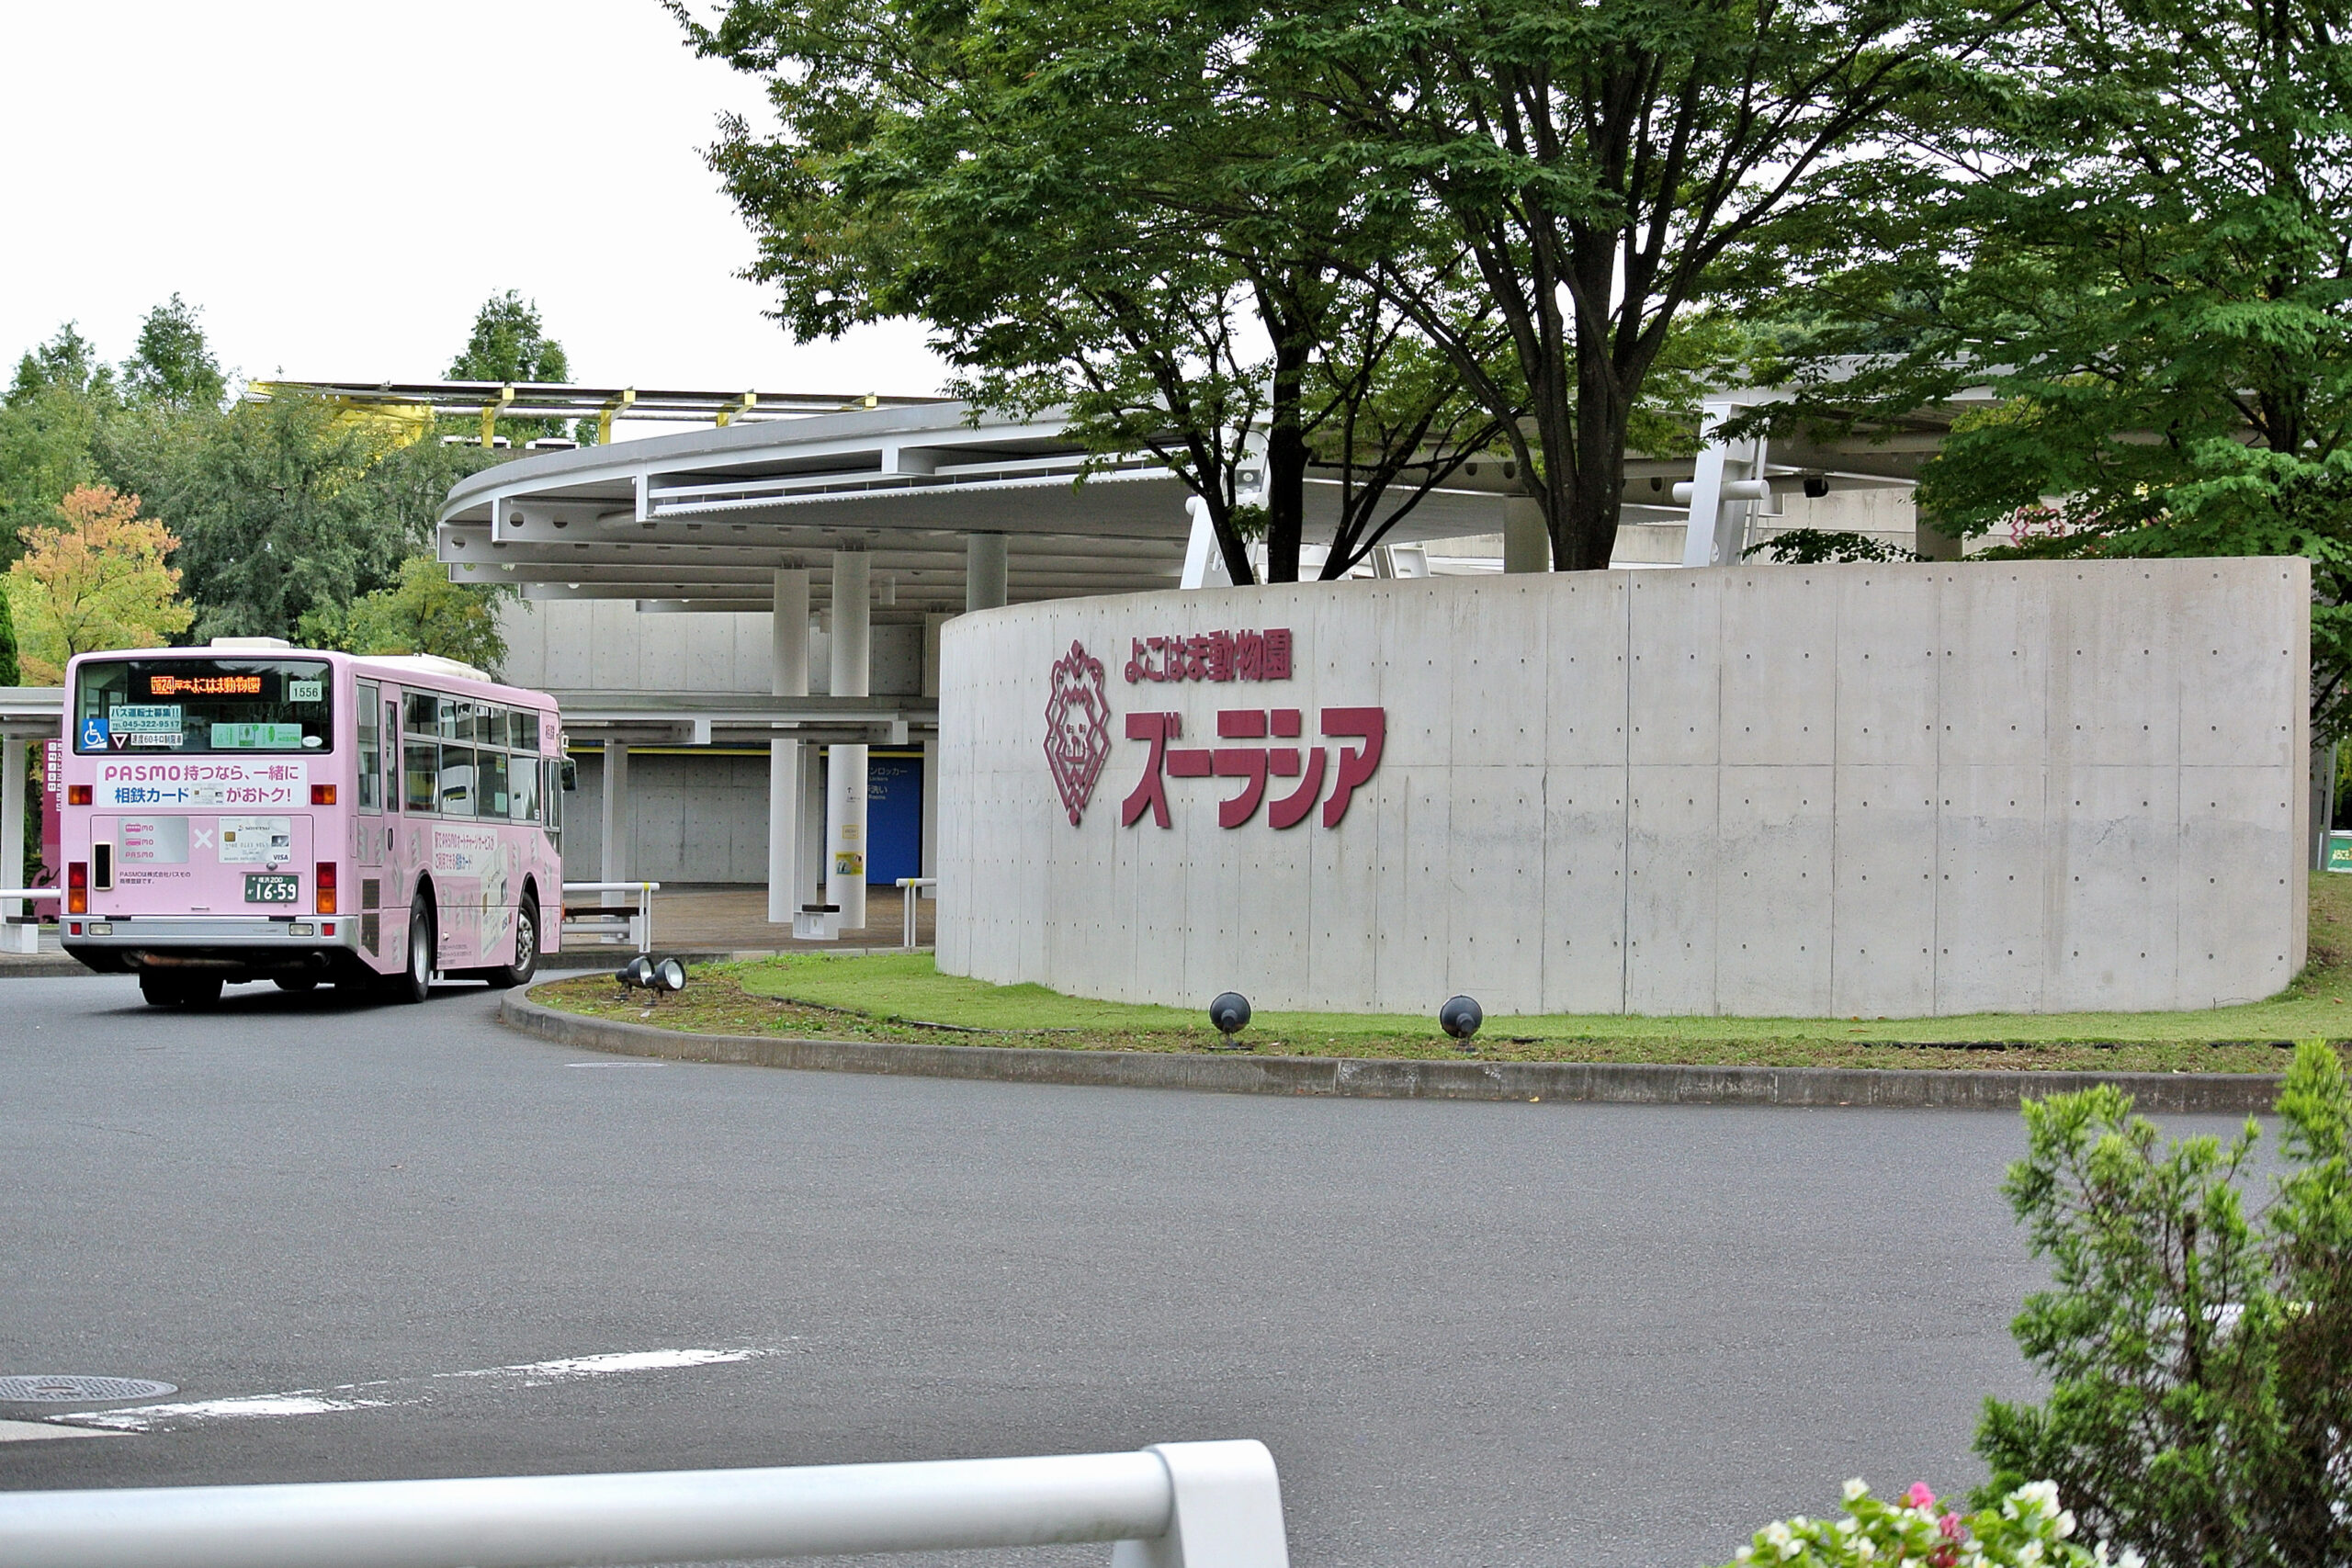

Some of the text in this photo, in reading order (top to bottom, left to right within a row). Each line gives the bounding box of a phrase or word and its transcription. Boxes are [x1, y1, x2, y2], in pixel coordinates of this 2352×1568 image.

[1125, 628, 1291, 682] よこはま動物園
[294, 688, 319, 697] 1556
[105, 765, 299, 781] PASMO持つなら、一緒に
[866, 767, 908, 775] ンロッカー
[1122, 706, 1385, 828] ズーラシア
[115, 787, 290, 804] 相鉄カード がおトク!
[256, 883, 297, 900] 16-59
